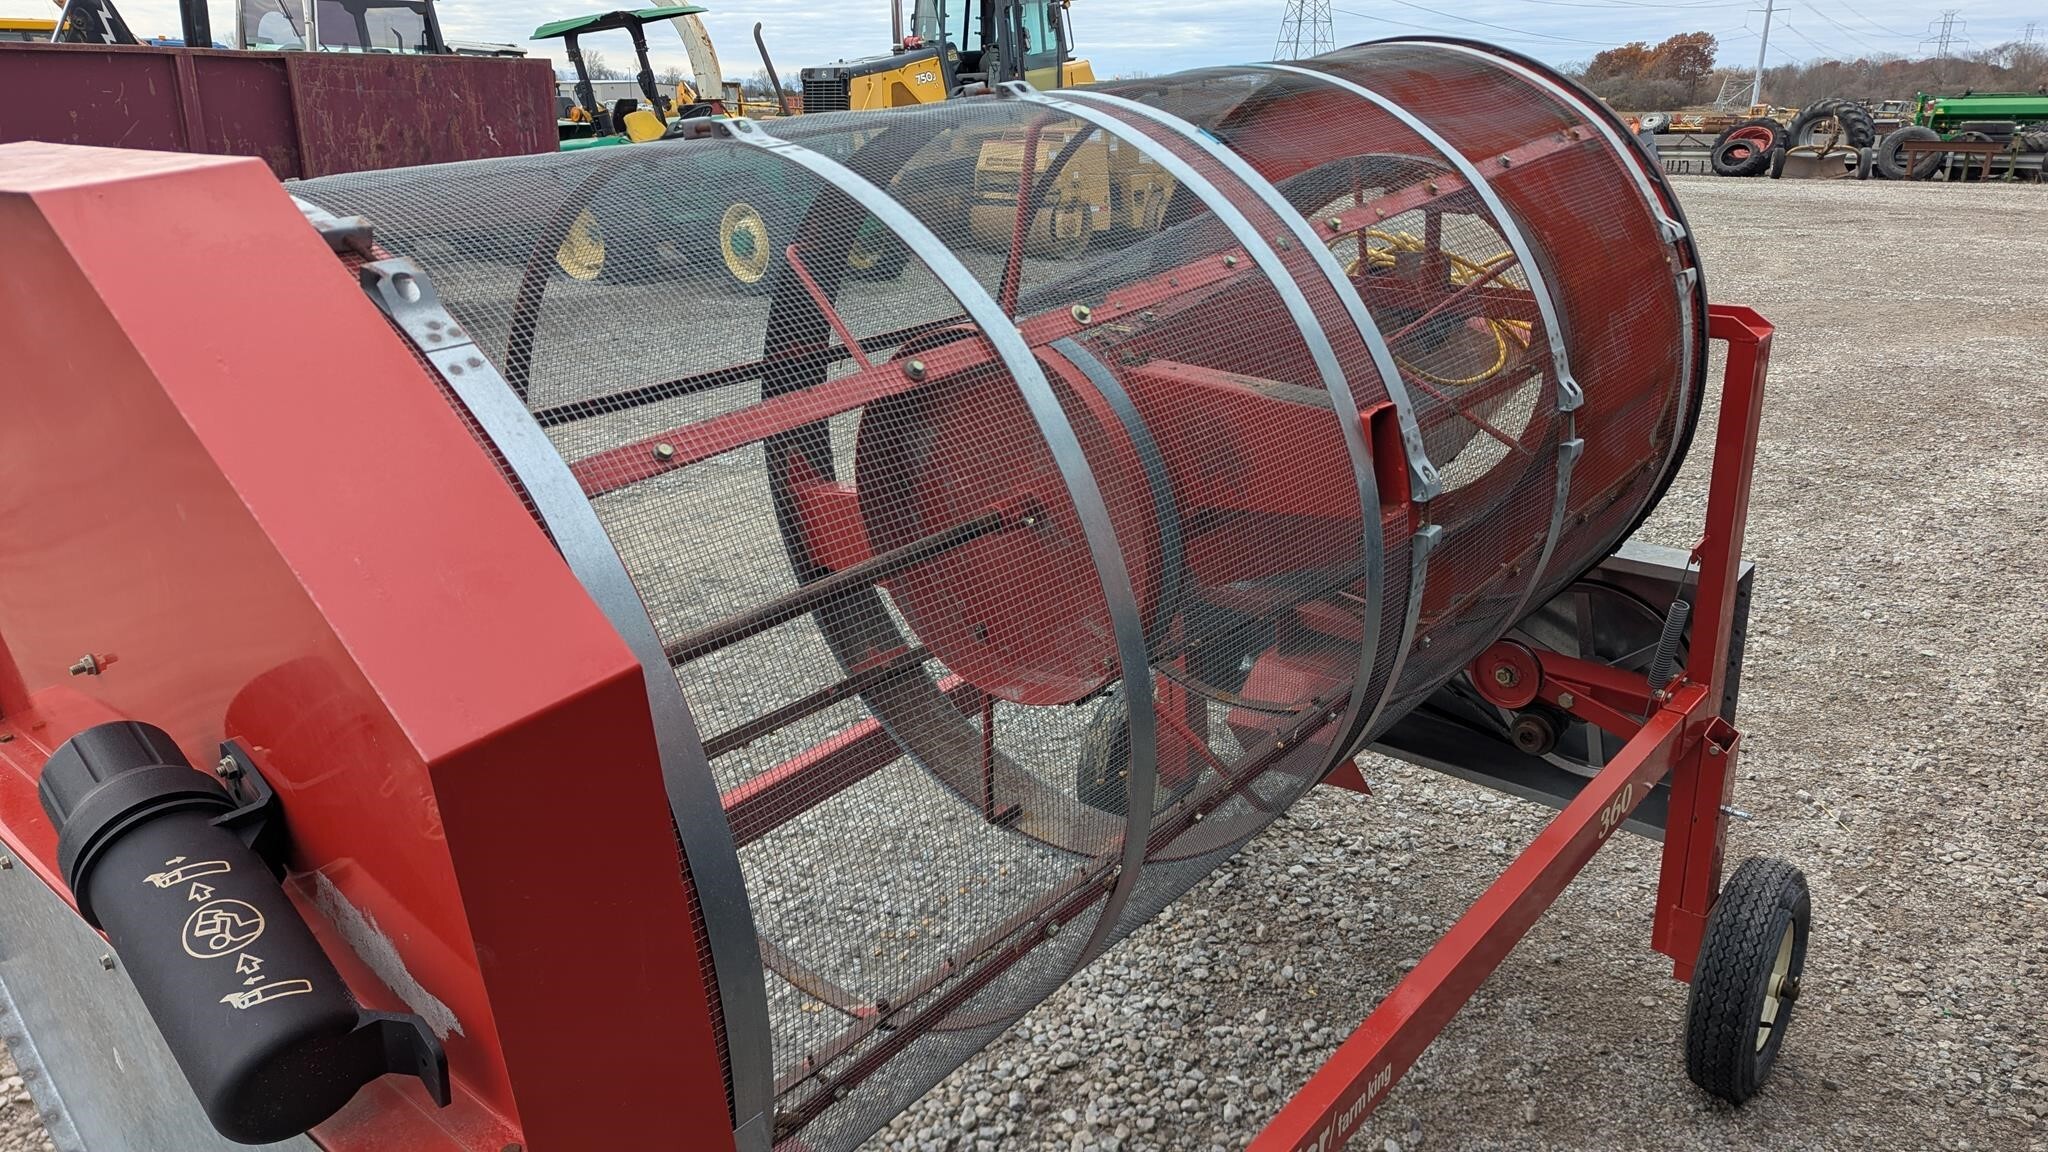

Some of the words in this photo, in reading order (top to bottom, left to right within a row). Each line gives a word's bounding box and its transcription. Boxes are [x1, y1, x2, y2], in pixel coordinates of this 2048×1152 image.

[1598, 783, 1633, 840] 360
[1337, 1092, 1366, 1137] farm
[1367, 1062, 1392, 1103] king
